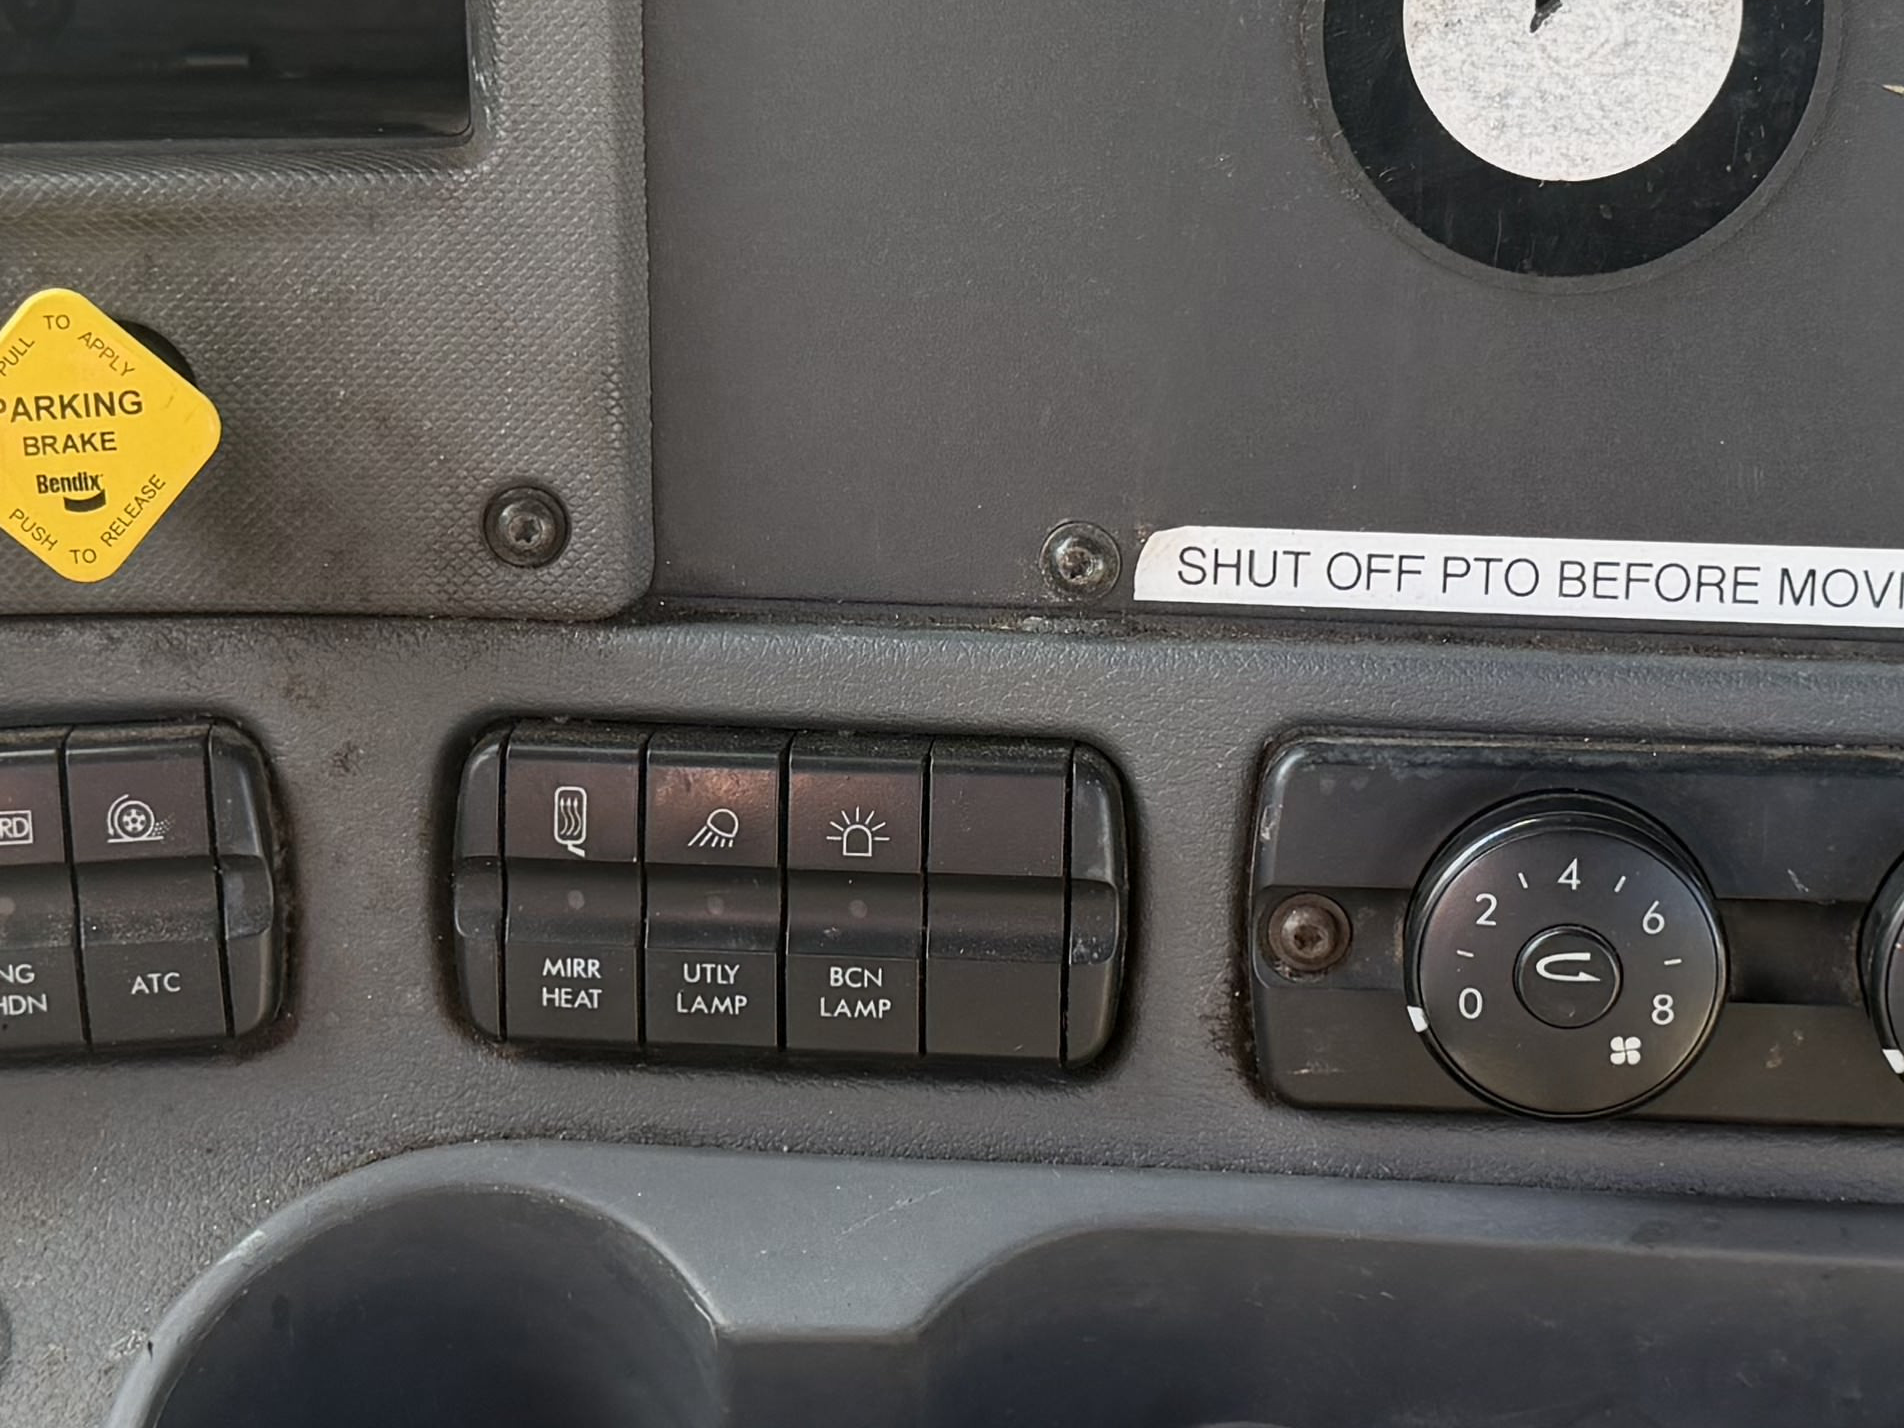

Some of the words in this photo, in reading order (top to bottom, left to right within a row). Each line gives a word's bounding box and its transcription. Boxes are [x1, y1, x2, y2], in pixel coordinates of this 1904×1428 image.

[43, 313, 71, 330] TO
[77, 331, 137, 378] APPLY
[22, 431, 118, 457] BRAKE
[36, 472, 103, 495] Bendix
[9, 508, 59, 551] PUSH
[69, 547, 97, 565] TO
[100, 473, 166, 547] RELEASE
[1177, 545, 1311, 589] SHUT
[1326, 551, 1425, 594] OFF
[1441, 555, 1541, 598] PTO
[1558, 559, 1760, 605] BEFORE
[1557, 857, 1581, 890] 4
[1475, 893, 1497, 926] 2
[1642, 900, 1665, 934] 6
[542, 957, 603, 981] MIRR
[682, 963, 740, 986] UTLY
[829, 965, 884, 989] BCN
[130, 972, 182, 995] ATC
[541, 986, 604, 1010] HEAT
[676, 991, 749, 1016] LAMP
[819, 996, 893, 1019] LAMP
[1459, 987, 1483, 1019] 0
[1651, 994, 1675, 1026] 8
